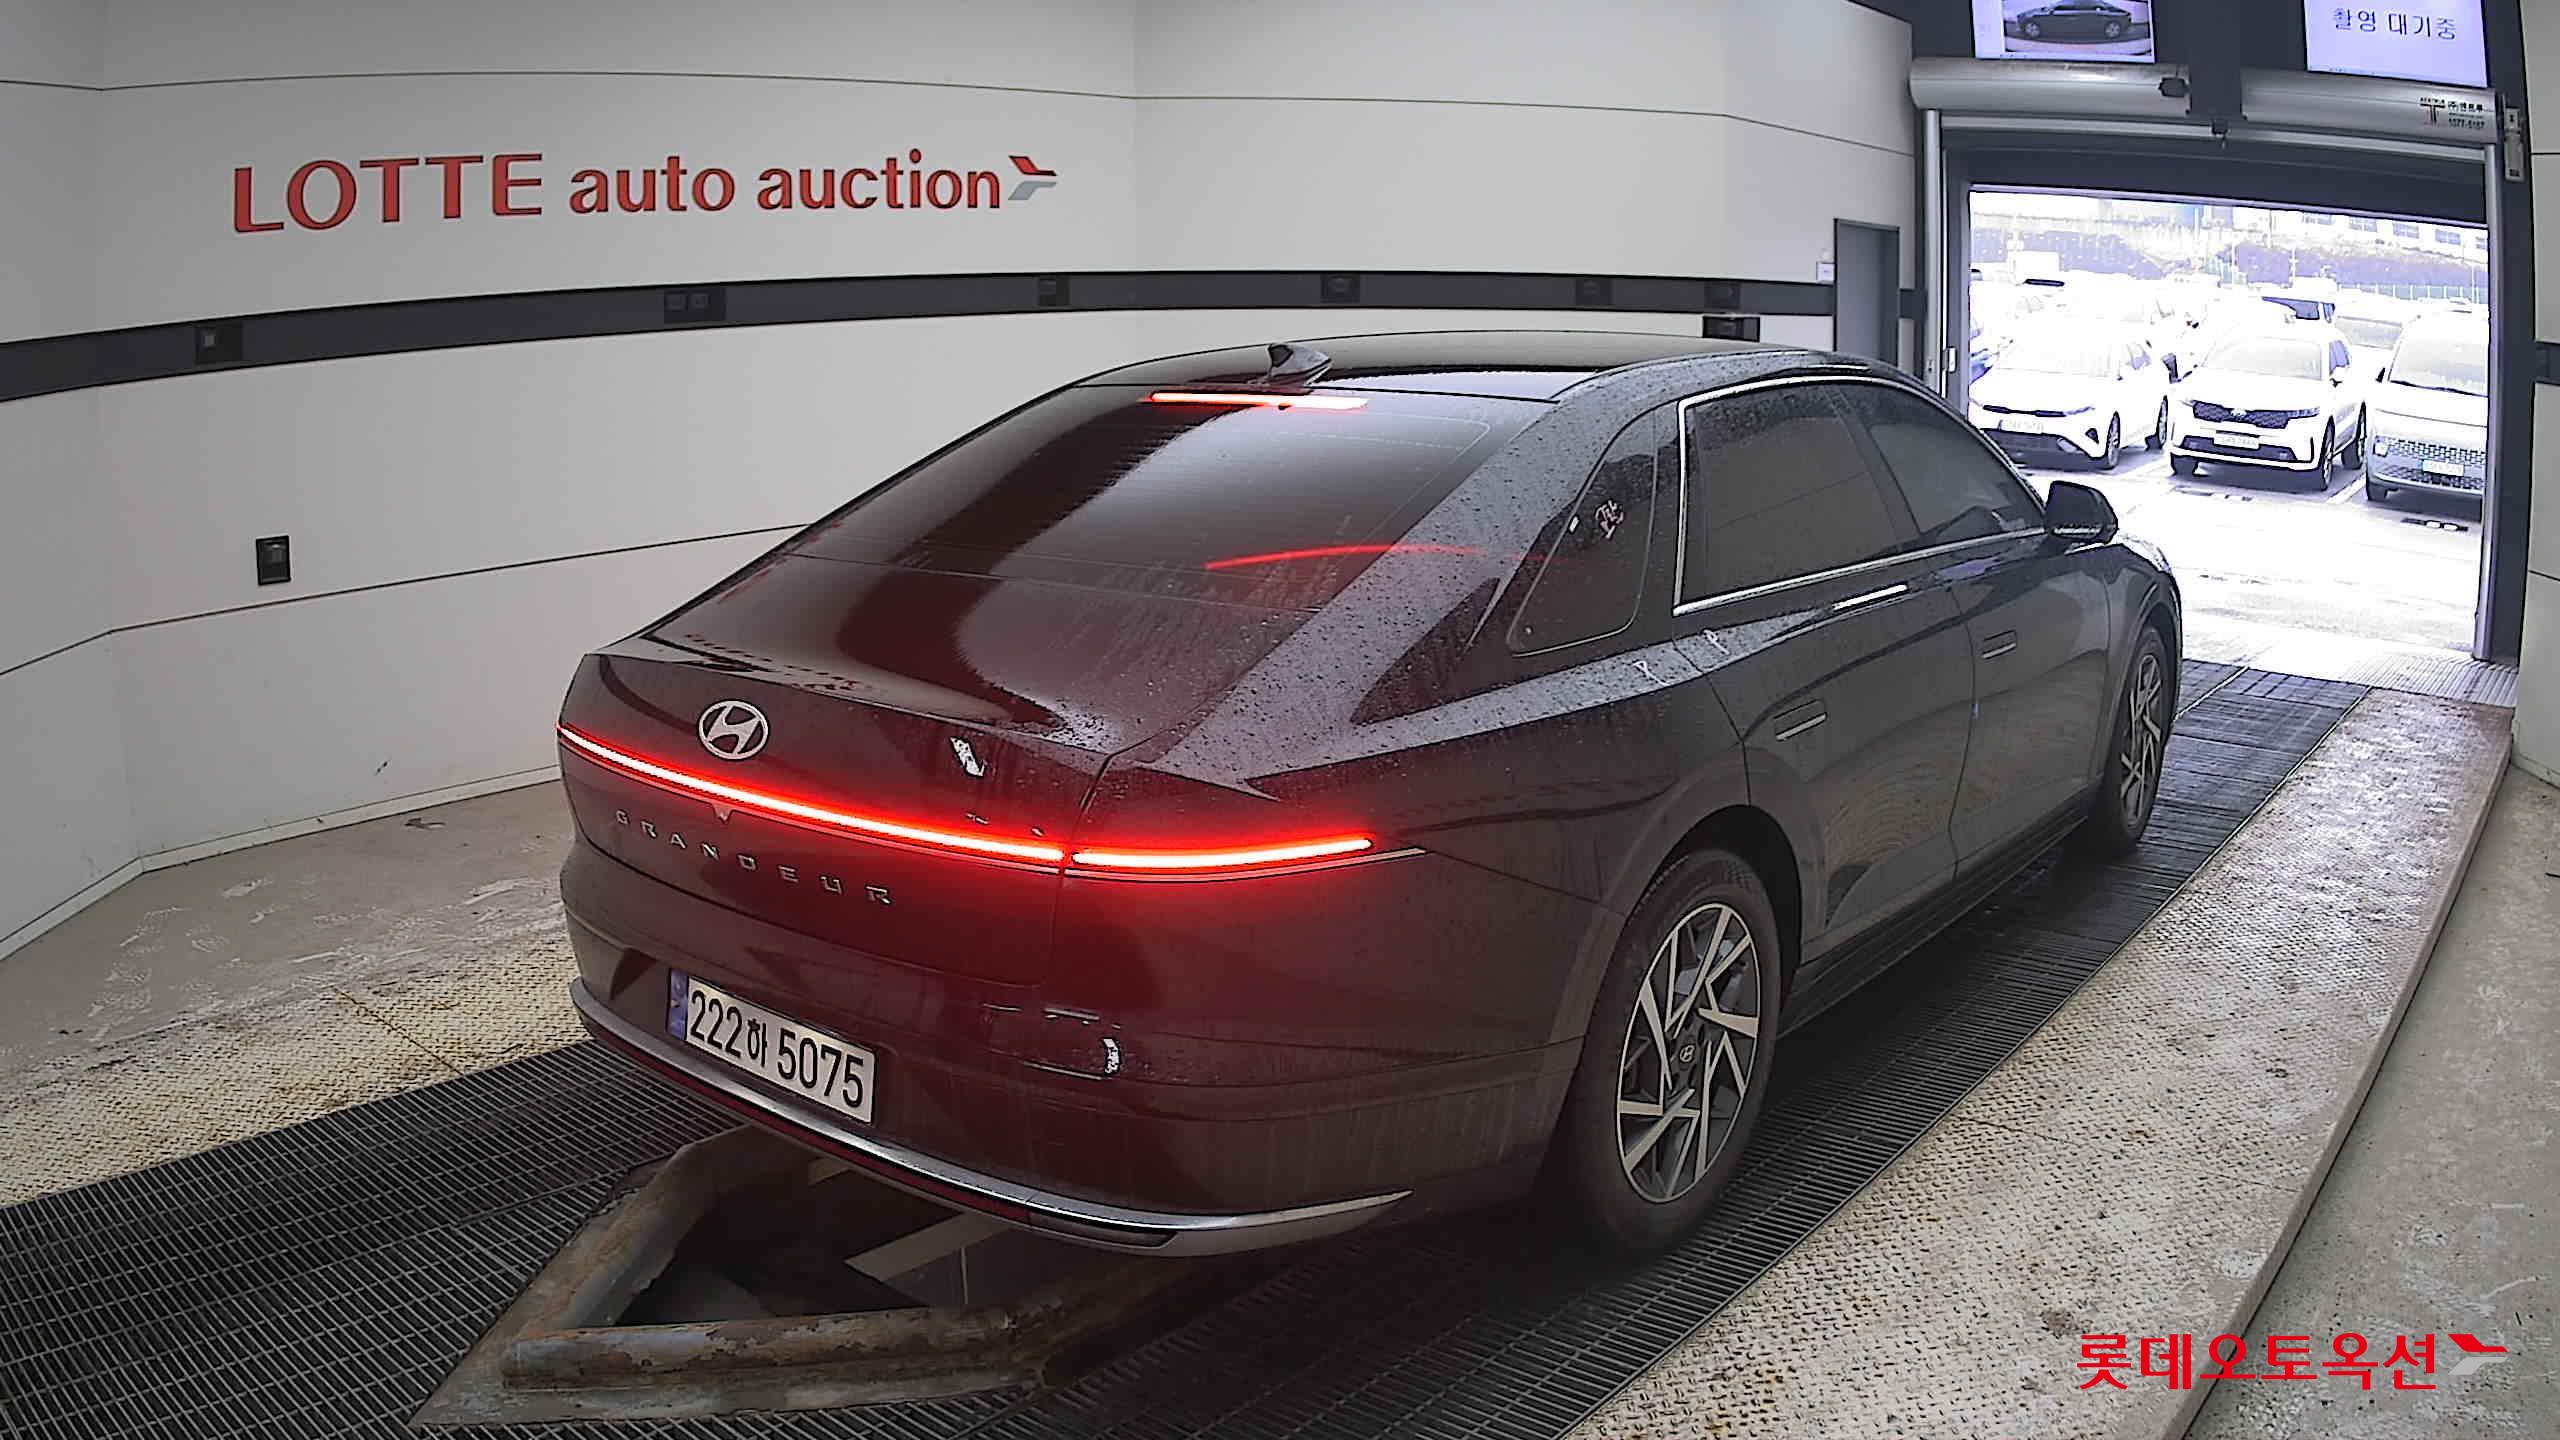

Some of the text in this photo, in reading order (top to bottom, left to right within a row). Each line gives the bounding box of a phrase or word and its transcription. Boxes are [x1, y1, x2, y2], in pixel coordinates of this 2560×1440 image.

[2334, 8, 2456, 40] 촬영 대기중
[234, 147, 1003, 233] LOTTE auto auction
[615, 809, 892, 905] GRANDEUR
[689, 989, 864, 1108] 222하 5075
